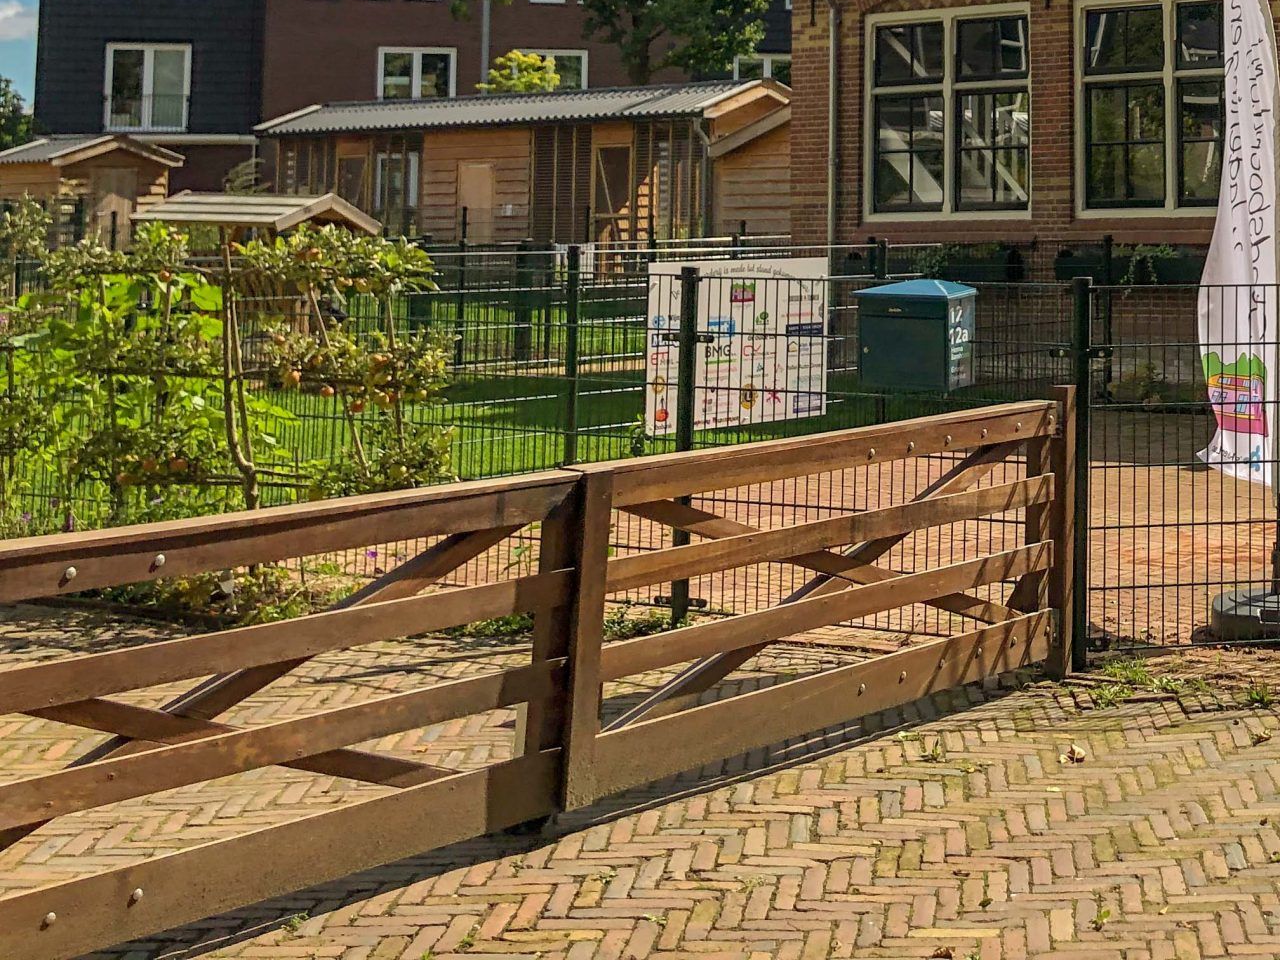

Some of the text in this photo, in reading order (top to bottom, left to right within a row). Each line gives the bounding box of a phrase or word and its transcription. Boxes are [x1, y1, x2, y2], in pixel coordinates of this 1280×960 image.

[949, 306, 963, 324] 12
[949, 326, 969, 345] 12a
[705, 344, 732, 359] BMG
